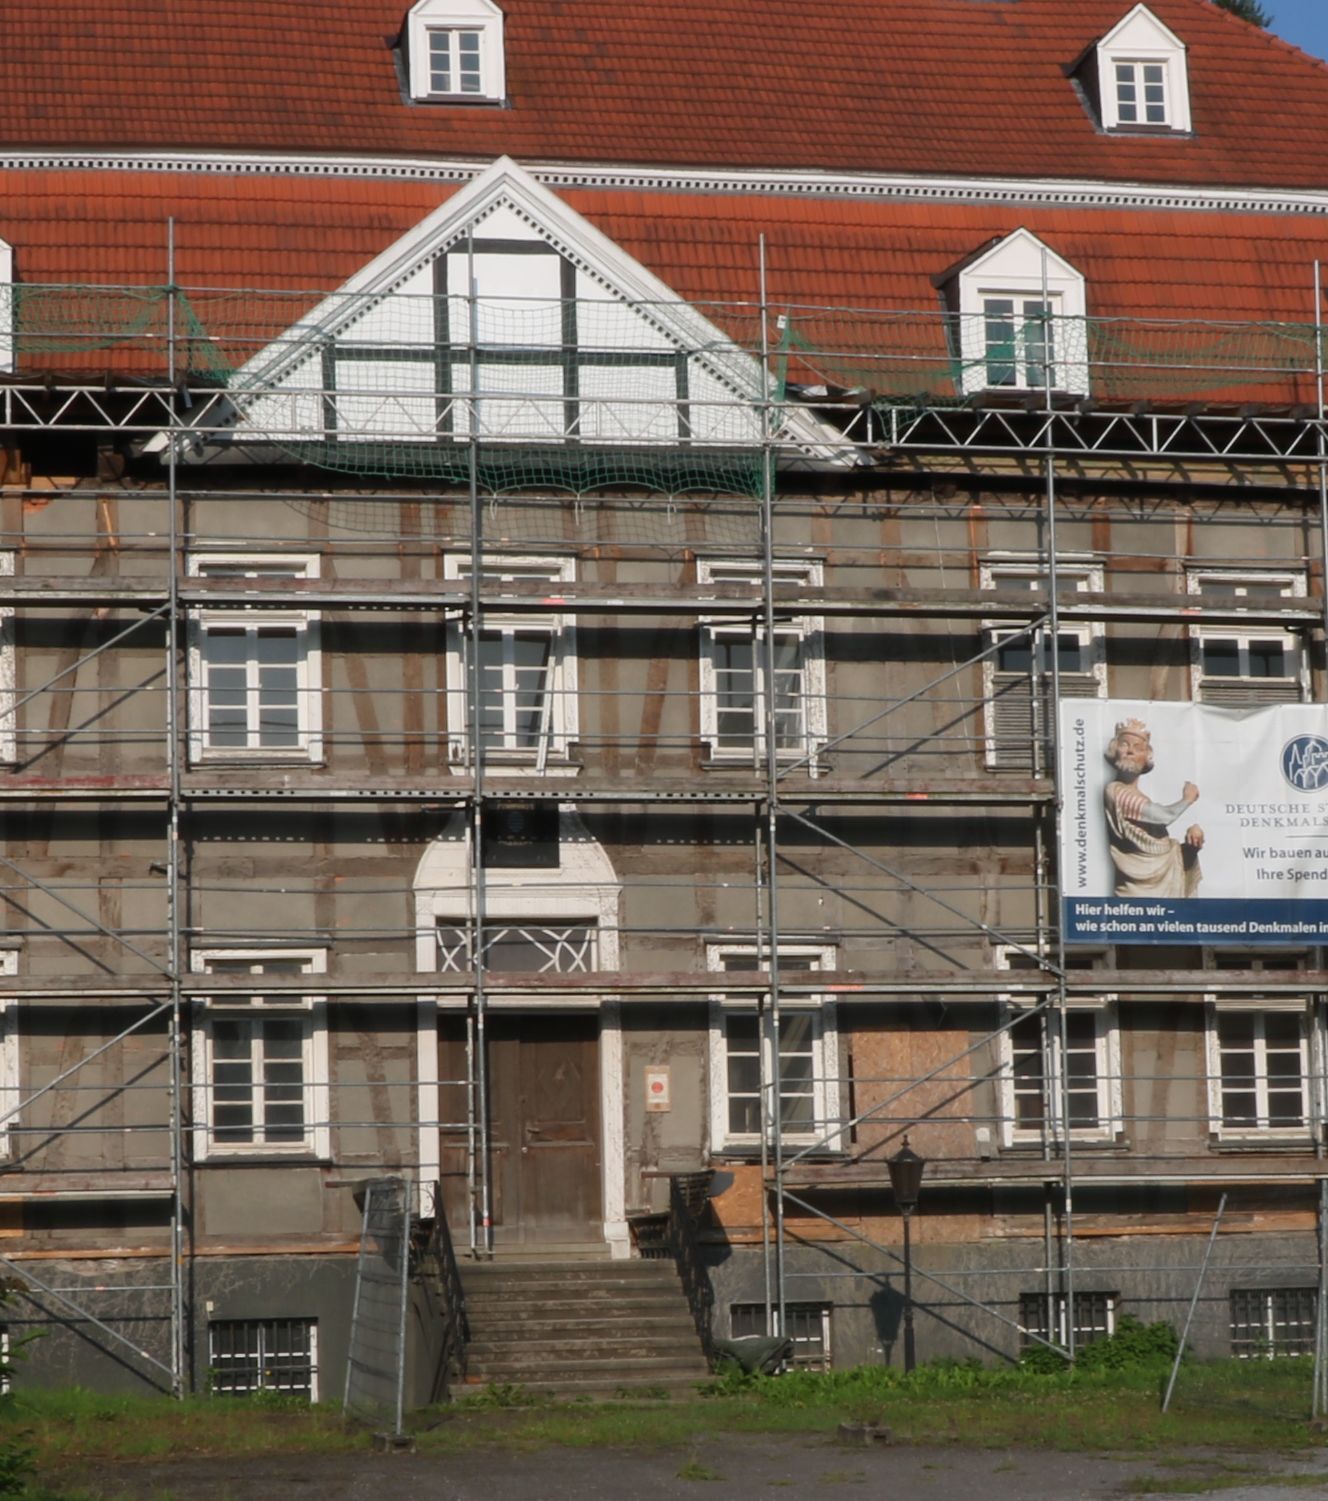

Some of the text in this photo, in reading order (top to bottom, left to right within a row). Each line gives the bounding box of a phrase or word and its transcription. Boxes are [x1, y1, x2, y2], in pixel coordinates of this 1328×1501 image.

[1076, 718, 1086, 888] www.denkmalschutz.de
[1225, 803, 1312, 814] DEUTSCHE
[1243, 847, 1266, 859] Wir
[1269, 847, 1313, 859] bauen
[1257, 868, 1284, 880] Ihre
[1076, 904, 1101, 915] Hier
[1104, 904, 1143, 916] helfen
[1146, 905, 1165, 916] wir
[1076, 921, 1097, 932] wie
[1100, 921, 1136, 932] schon
[1139, 923, 1155, 932] an
[1158, 921, 1194, 932] vielen
[1196, 921, 1246, 933] tausend
[1250, 921, 1316, 933] Denkmalen
